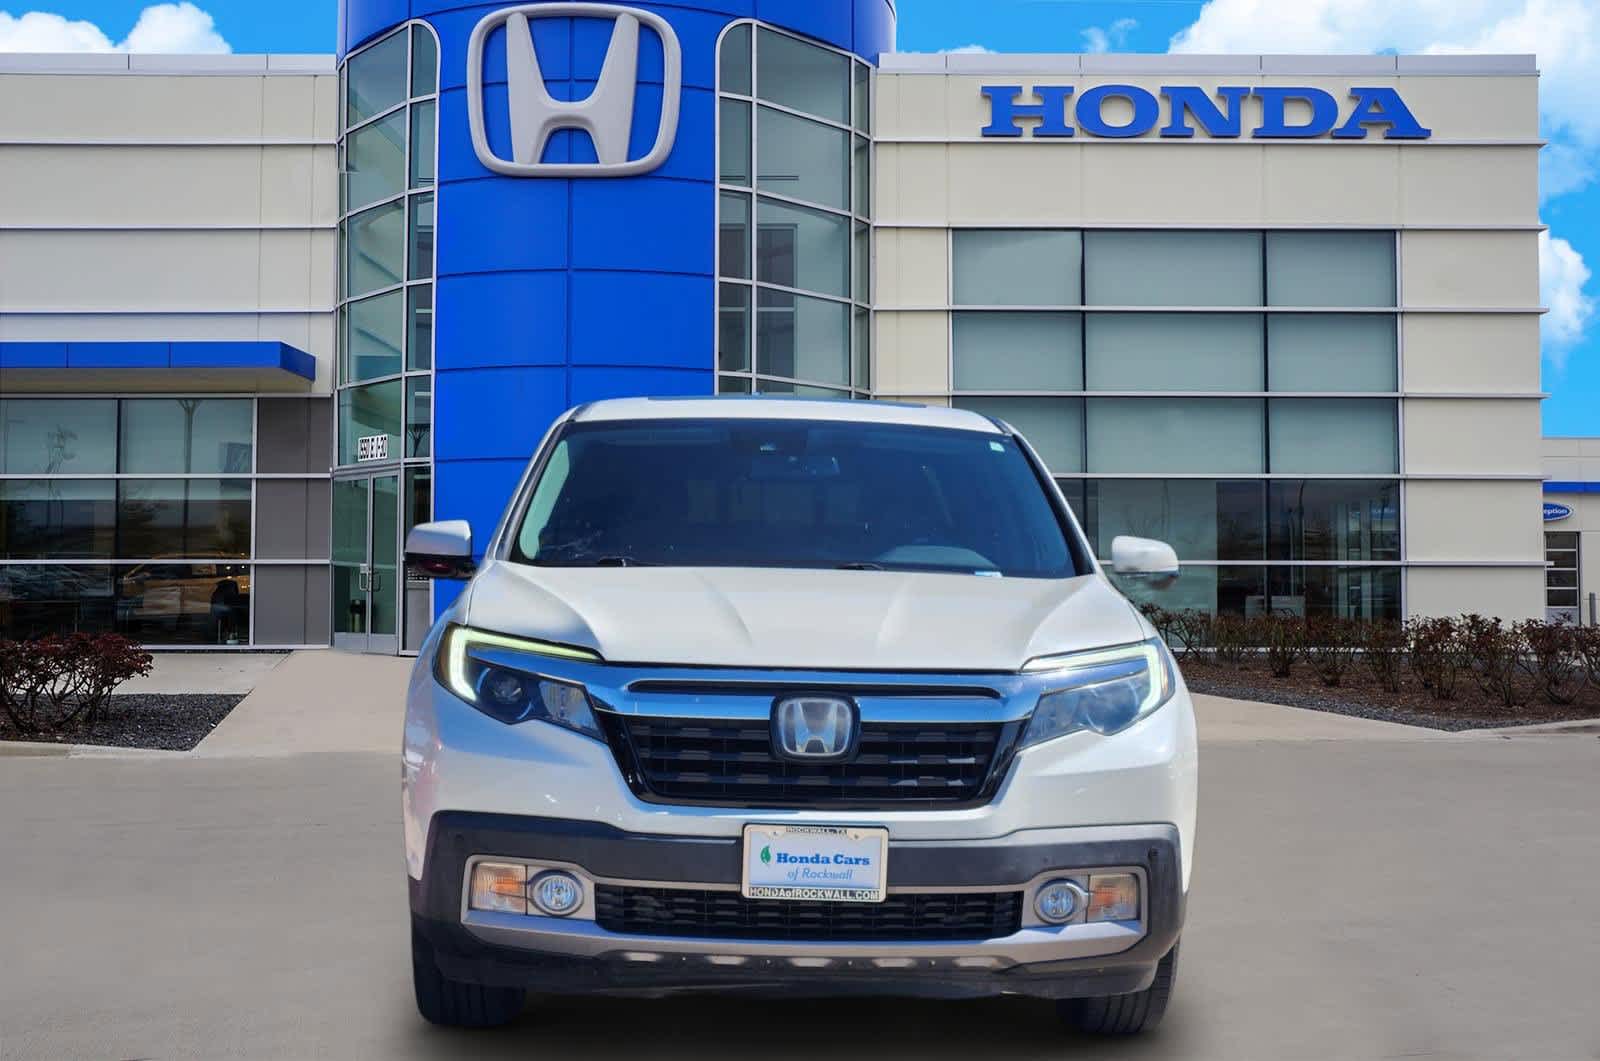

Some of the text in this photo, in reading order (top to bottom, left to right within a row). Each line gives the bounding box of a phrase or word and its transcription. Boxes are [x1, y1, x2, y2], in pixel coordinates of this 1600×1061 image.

[981, 84, 1431, 139] HONDA
[776, 852, 870, 865] Honda Cars
[787, 868, 853, 880] of Rockwall
[749, 888, 881, 900] HONDAofROCKWALL.COM
